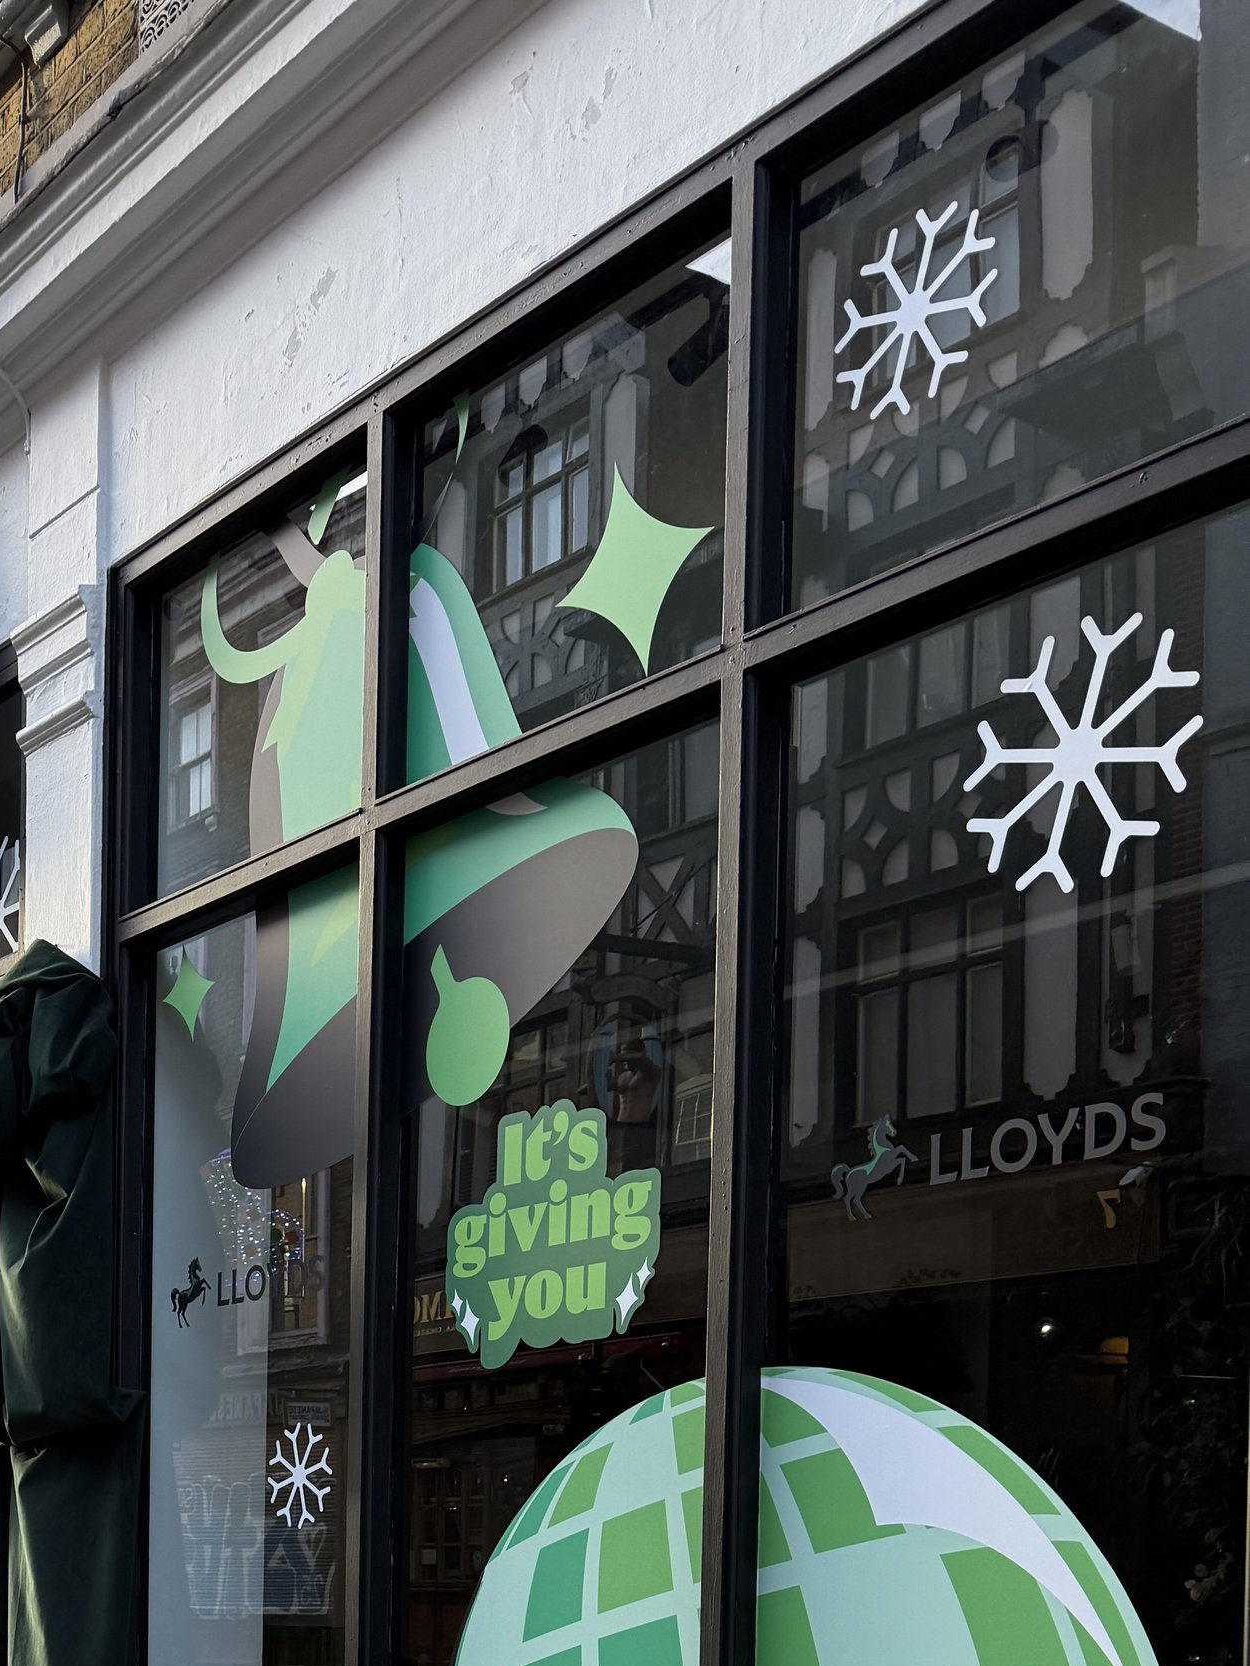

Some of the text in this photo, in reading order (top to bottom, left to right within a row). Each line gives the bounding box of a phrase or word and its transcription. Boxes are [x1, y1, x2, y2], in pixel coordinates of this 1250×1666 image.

[503, 1110, 599, 1187] It's
[929, 1092, 1167, 1186] LLOYDS
[452, 1178, 653, 1279] giving
[217, 1255, 325, 1307] LLOYDS
[488, 1261, 607, 1341] you
